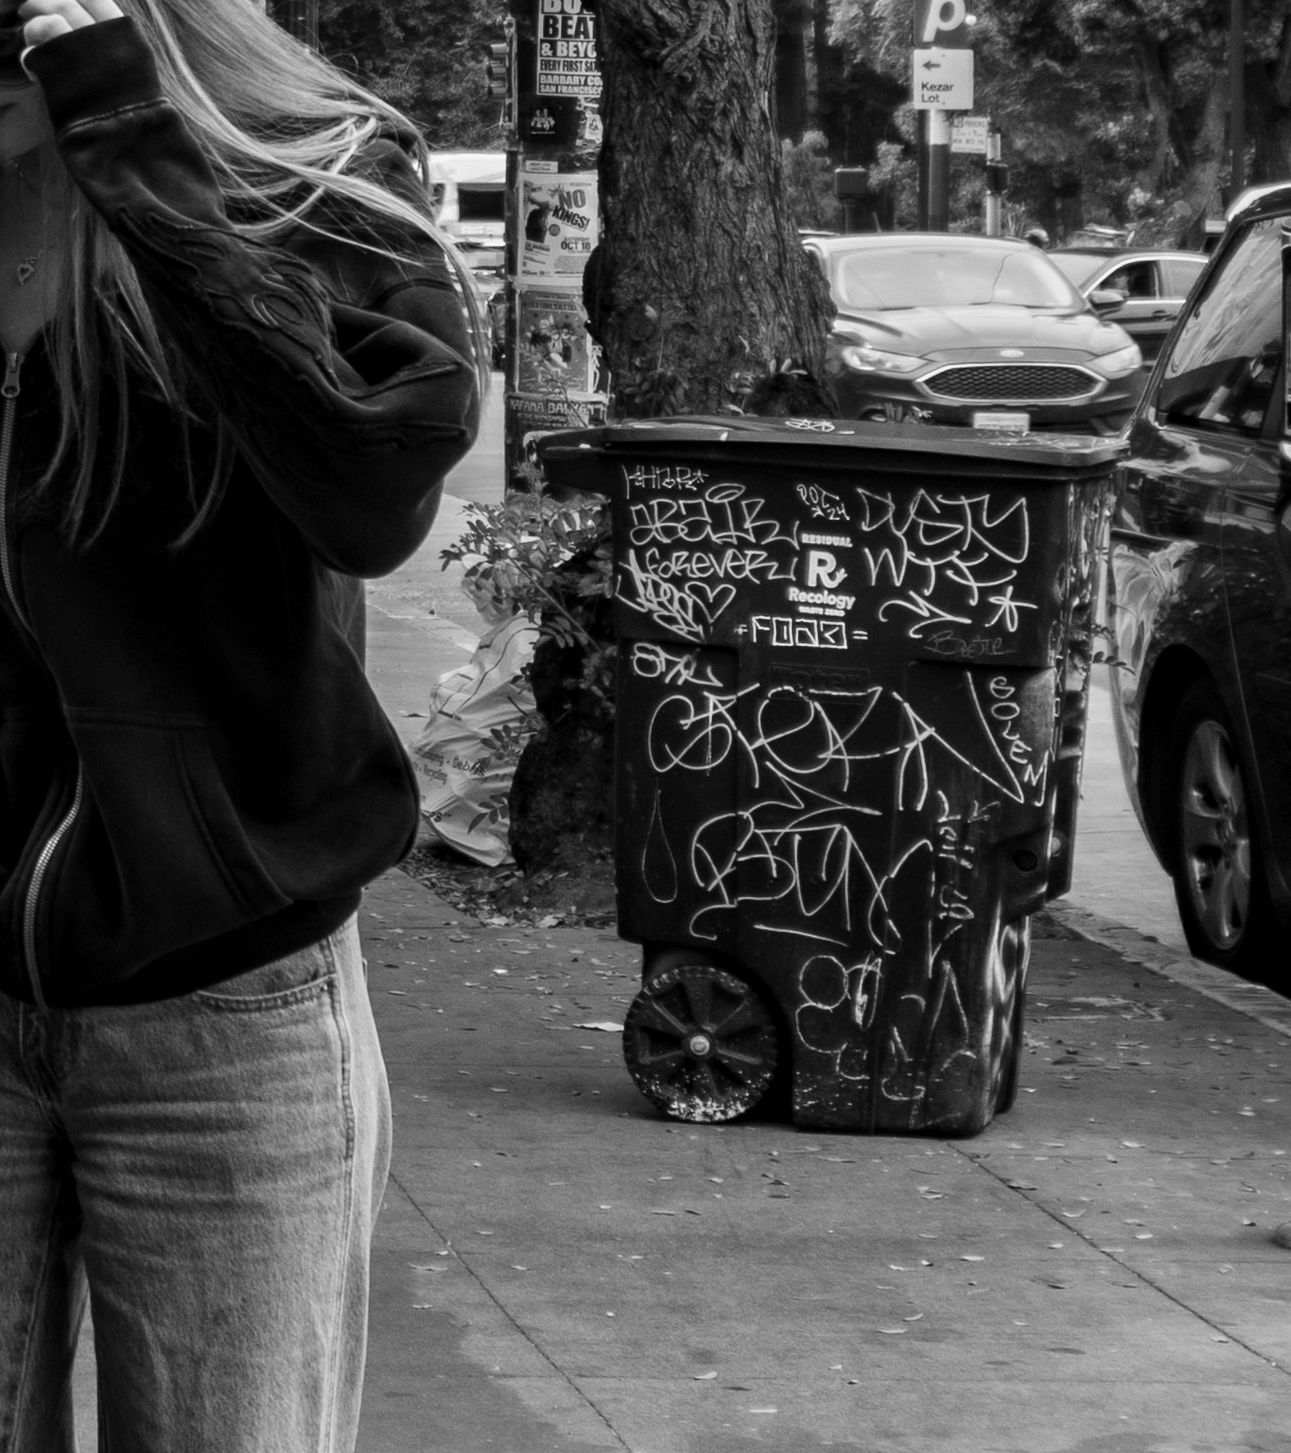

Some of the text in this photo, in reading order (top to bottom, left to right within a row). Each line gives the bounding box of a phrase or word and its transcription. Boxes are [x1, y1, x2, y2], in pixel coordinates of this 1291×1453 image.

[540, 75, 585, 85] BARBARY
[540, 84, 556, 93] SAN
[921, 82, 955, 92] Kezar
[921, 94, 940, 103] Lot
[559, 189, 586, 210] NO
[551, 204, 591, 230] KINGS!
[561, 241, 591, 251] OCT 18
[801, 534, 853, 548] RESIDUAL
[788, 586, 857, 610] Recology
